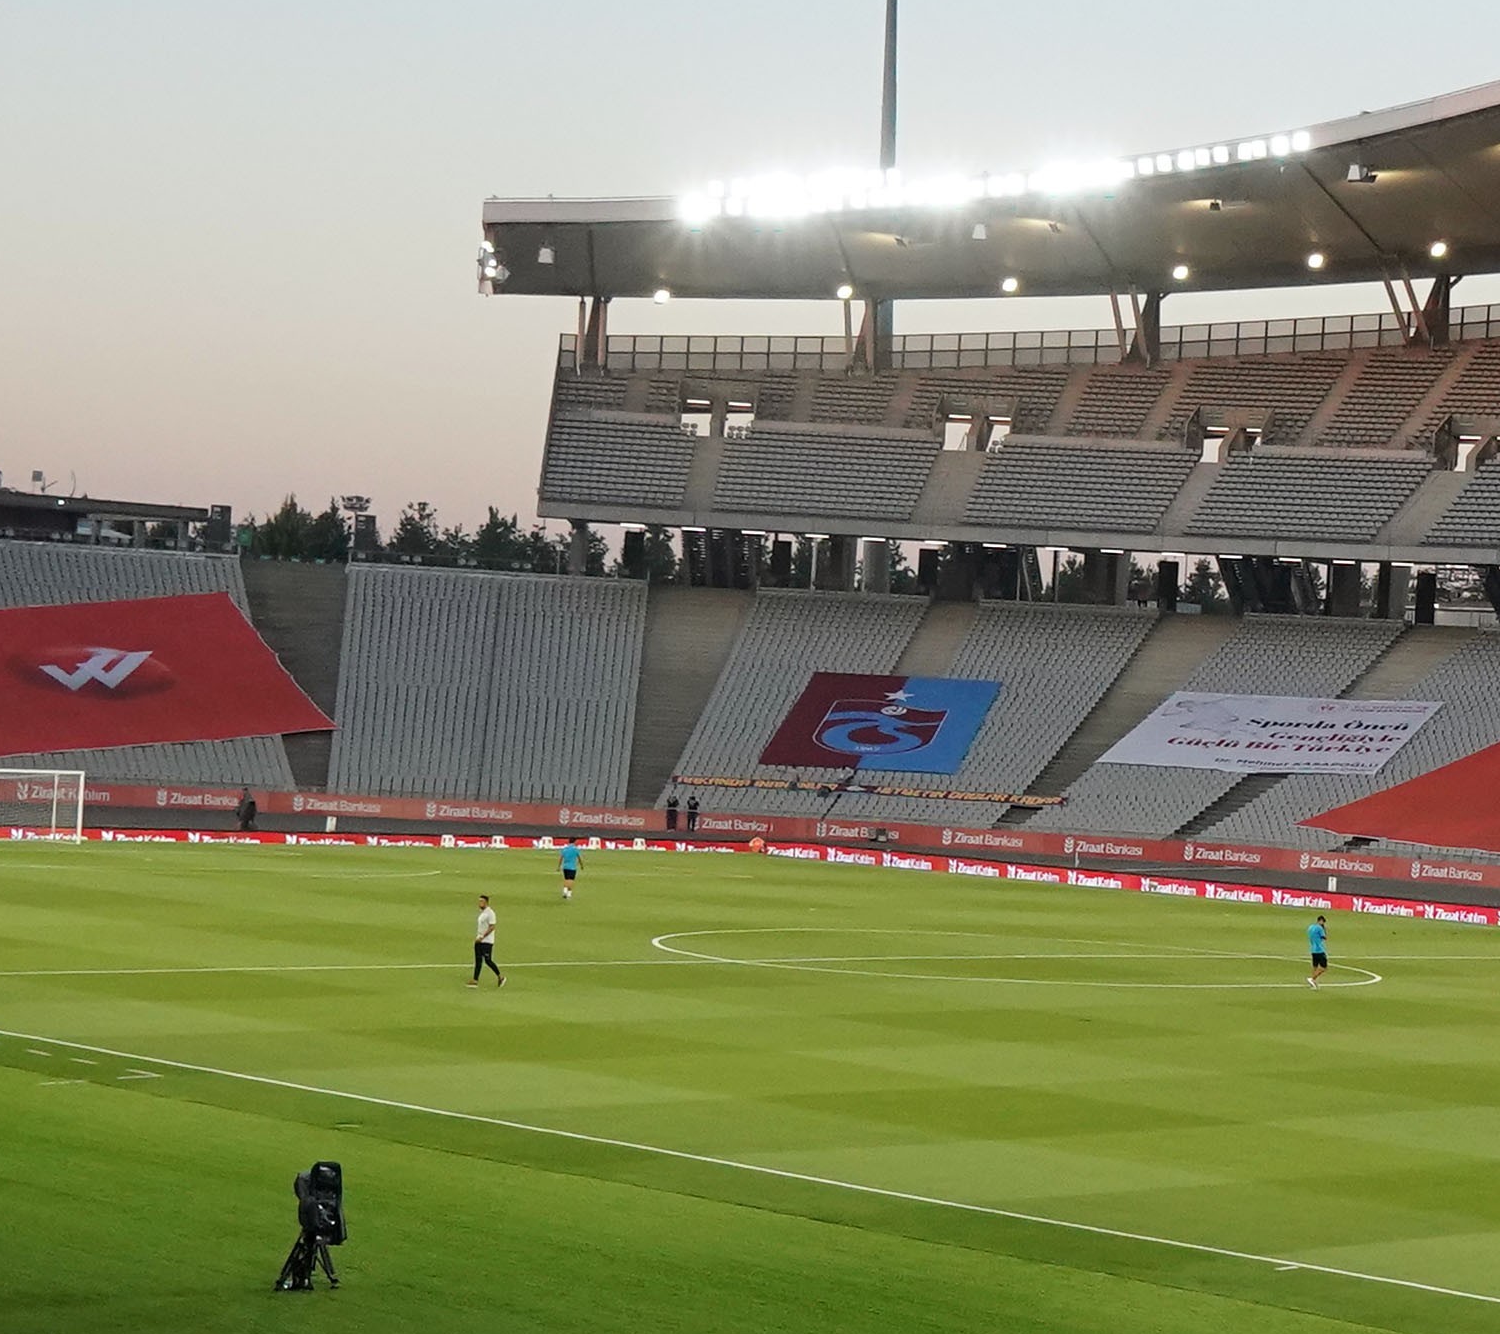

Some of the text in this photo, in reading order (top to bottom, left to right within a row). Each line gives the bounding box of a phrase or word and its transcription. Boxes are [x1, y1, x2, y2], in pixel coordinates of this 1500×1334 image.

[1246, 717, 1336, 731] Sporda
[1167, 736, 1391, 755] Güçlü Bir Türkiye
[306, 797, 339, 811] Ziraat
[954, 831, 1023, 848] Ziraat Bankası
[1194, 846, 1261, 864] Ziraat Bankası
[1422, 864, 1482, 881] Ziraat Bankası
